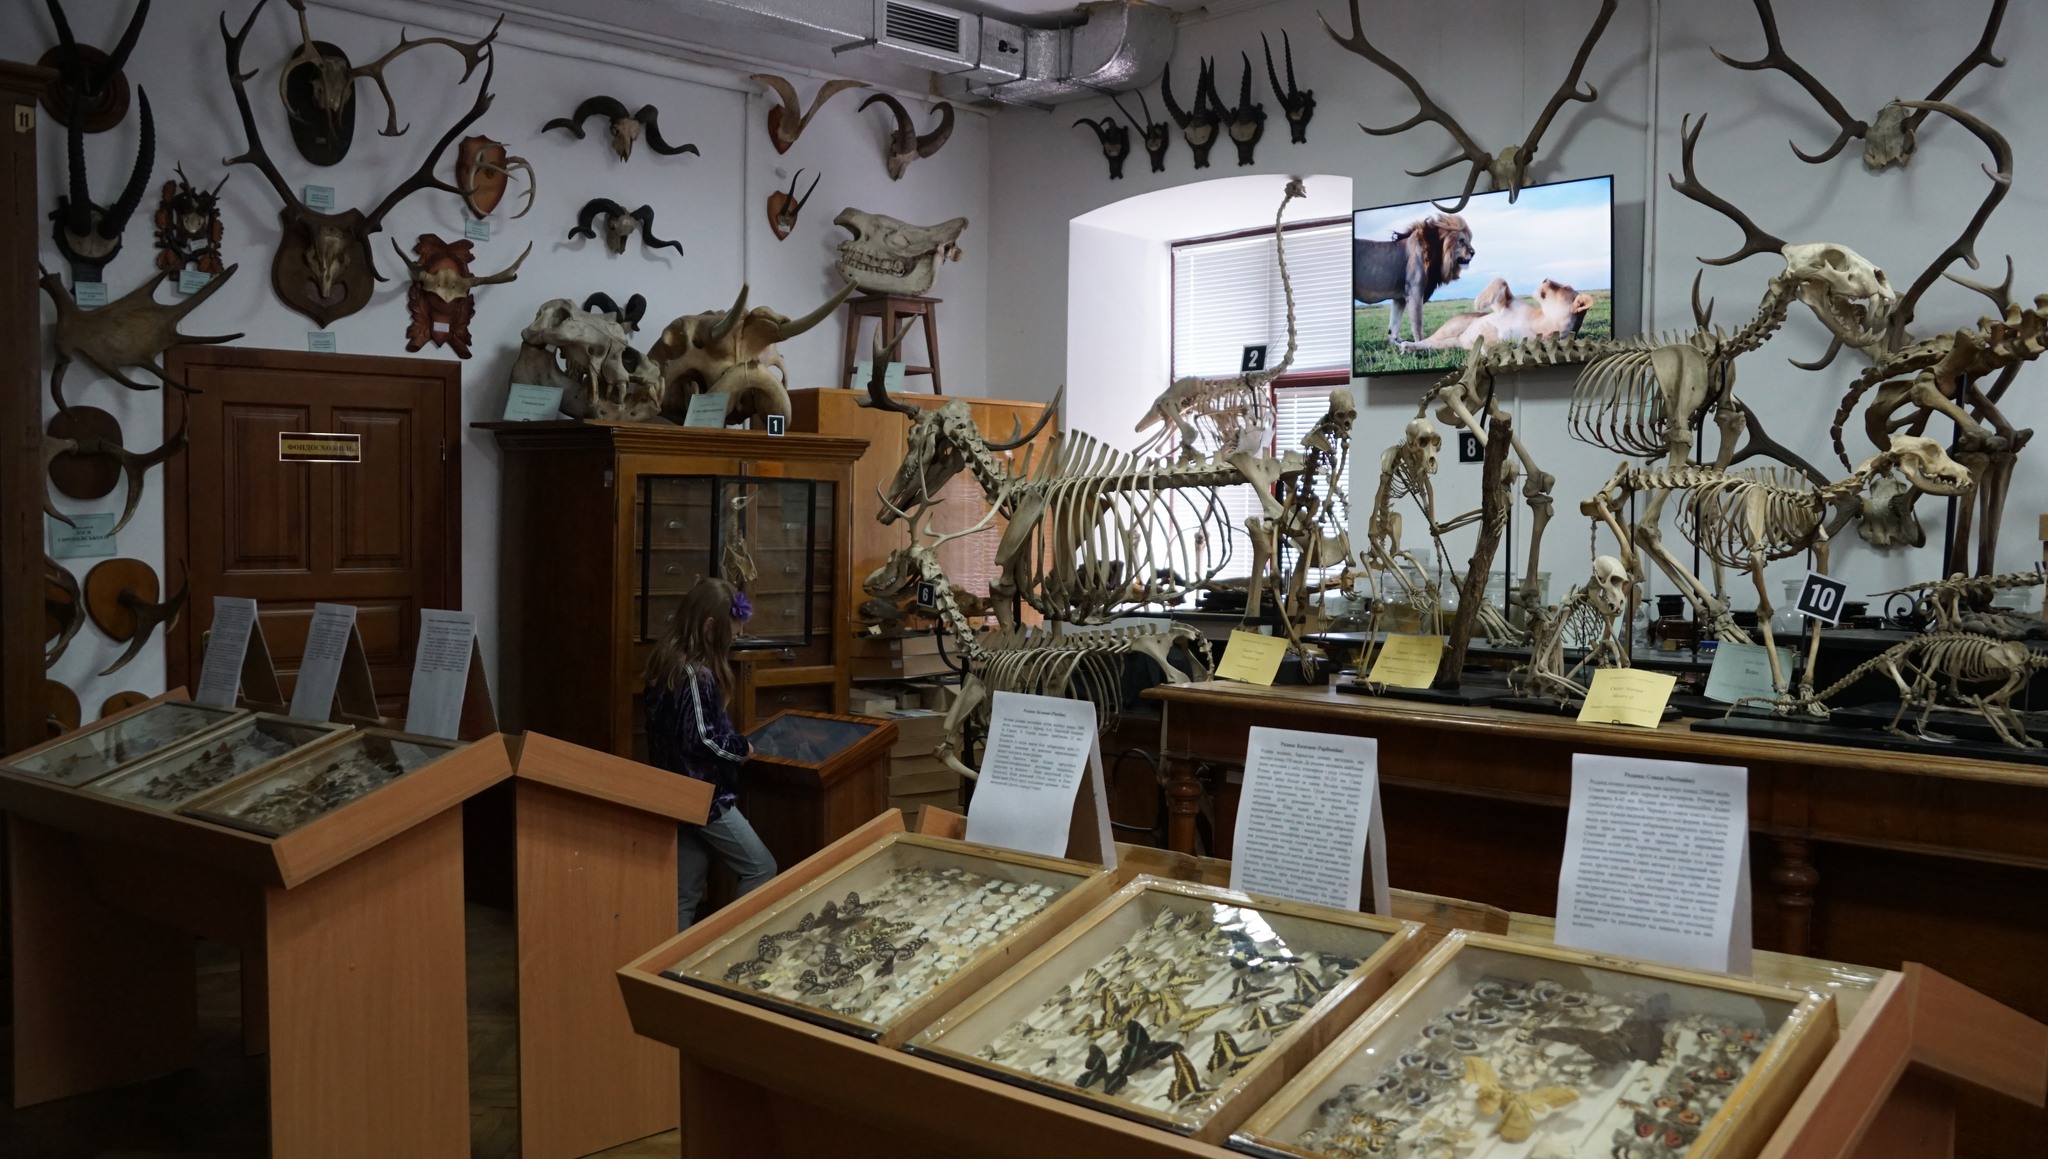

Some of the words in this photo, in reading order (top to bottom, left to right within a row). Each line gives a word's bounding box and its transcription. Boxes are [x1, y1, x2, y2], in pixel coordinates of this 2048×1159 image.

[18, 112, 29, 128] 11
[1248, 349, 1259, 368] 2
[772, 419, 778, 432] 1
[1467, 437, 1476, 458] 8
[922, 587, 929, 602] 6
[1809, 583, 1837, 612] 10
